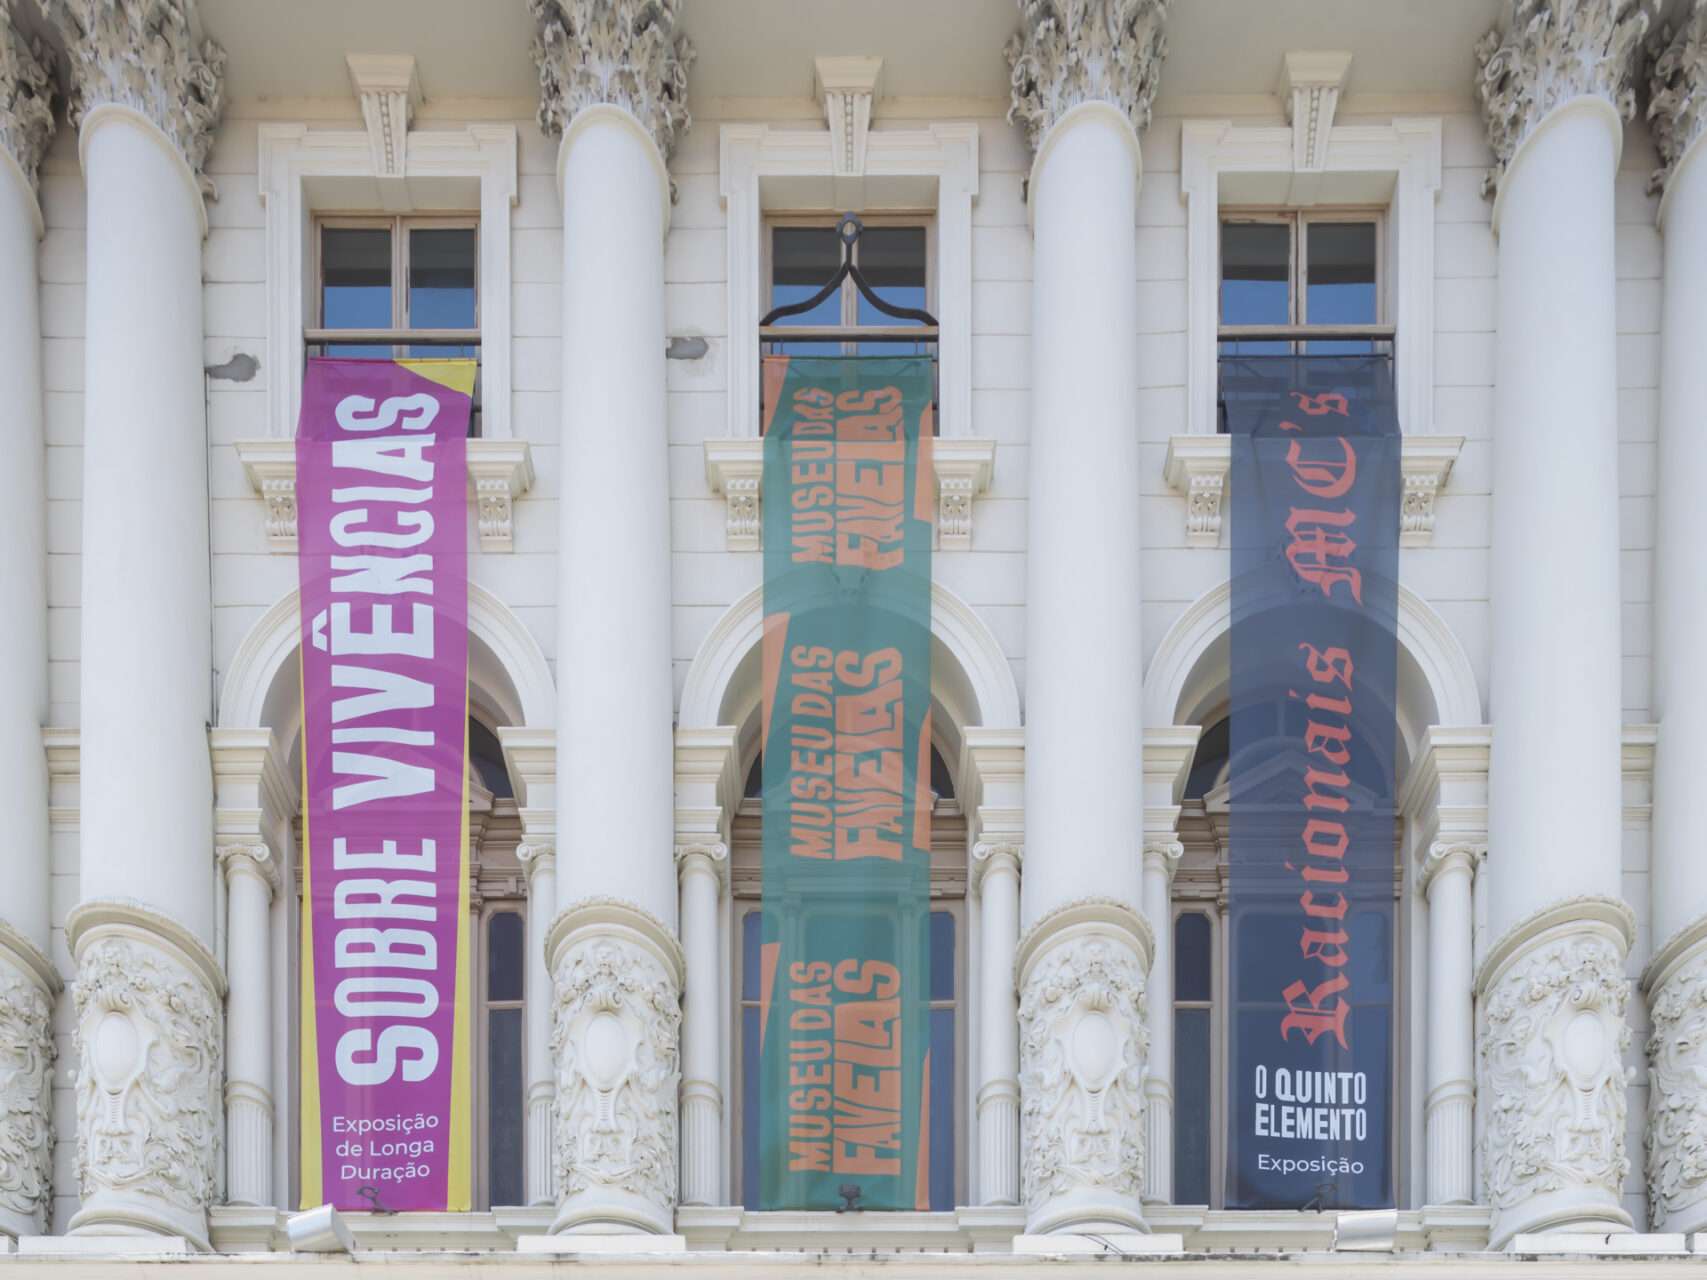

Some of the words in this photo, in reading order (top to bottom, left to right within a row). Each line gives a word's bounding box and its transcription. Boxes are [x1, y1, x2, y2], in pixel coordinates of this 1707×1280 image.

[792, 386, 835, 437] DAS
[791, 440, 835, 565] MUSEU
[835, 385, 905, 572] FAVELAS
[312, 392, 440, 811] VIVÊNCIAS
[790, 645, 834, 718] DAS
[790, 729, 834, 861] MUSEU
[834, 646, 904, 862] FAVELAS
[1279, 642, 1355, 1051] Racionais
[333, 836, 439, 1086] SOBRE
[788, 960, 833, 1031] DAS
[788, 1039, 833, 1173] MUSEU
[833, 958, 901, 1176] FAVELAS
[1255, 1064, 1267, 1099] O
[1275, 1067, 1367, 1105] QUINTO
[333, 1112, 439, 1136] Exposição
[335, 1140, 363, 1157] de
[370, 1139, 434, 1158] Longa
[1255, 1102, 1367, 1141] ELEMENTO
[1258, 1153, 1364, 1176] Exposição
[341, 1162, 430, 1183] Duração
